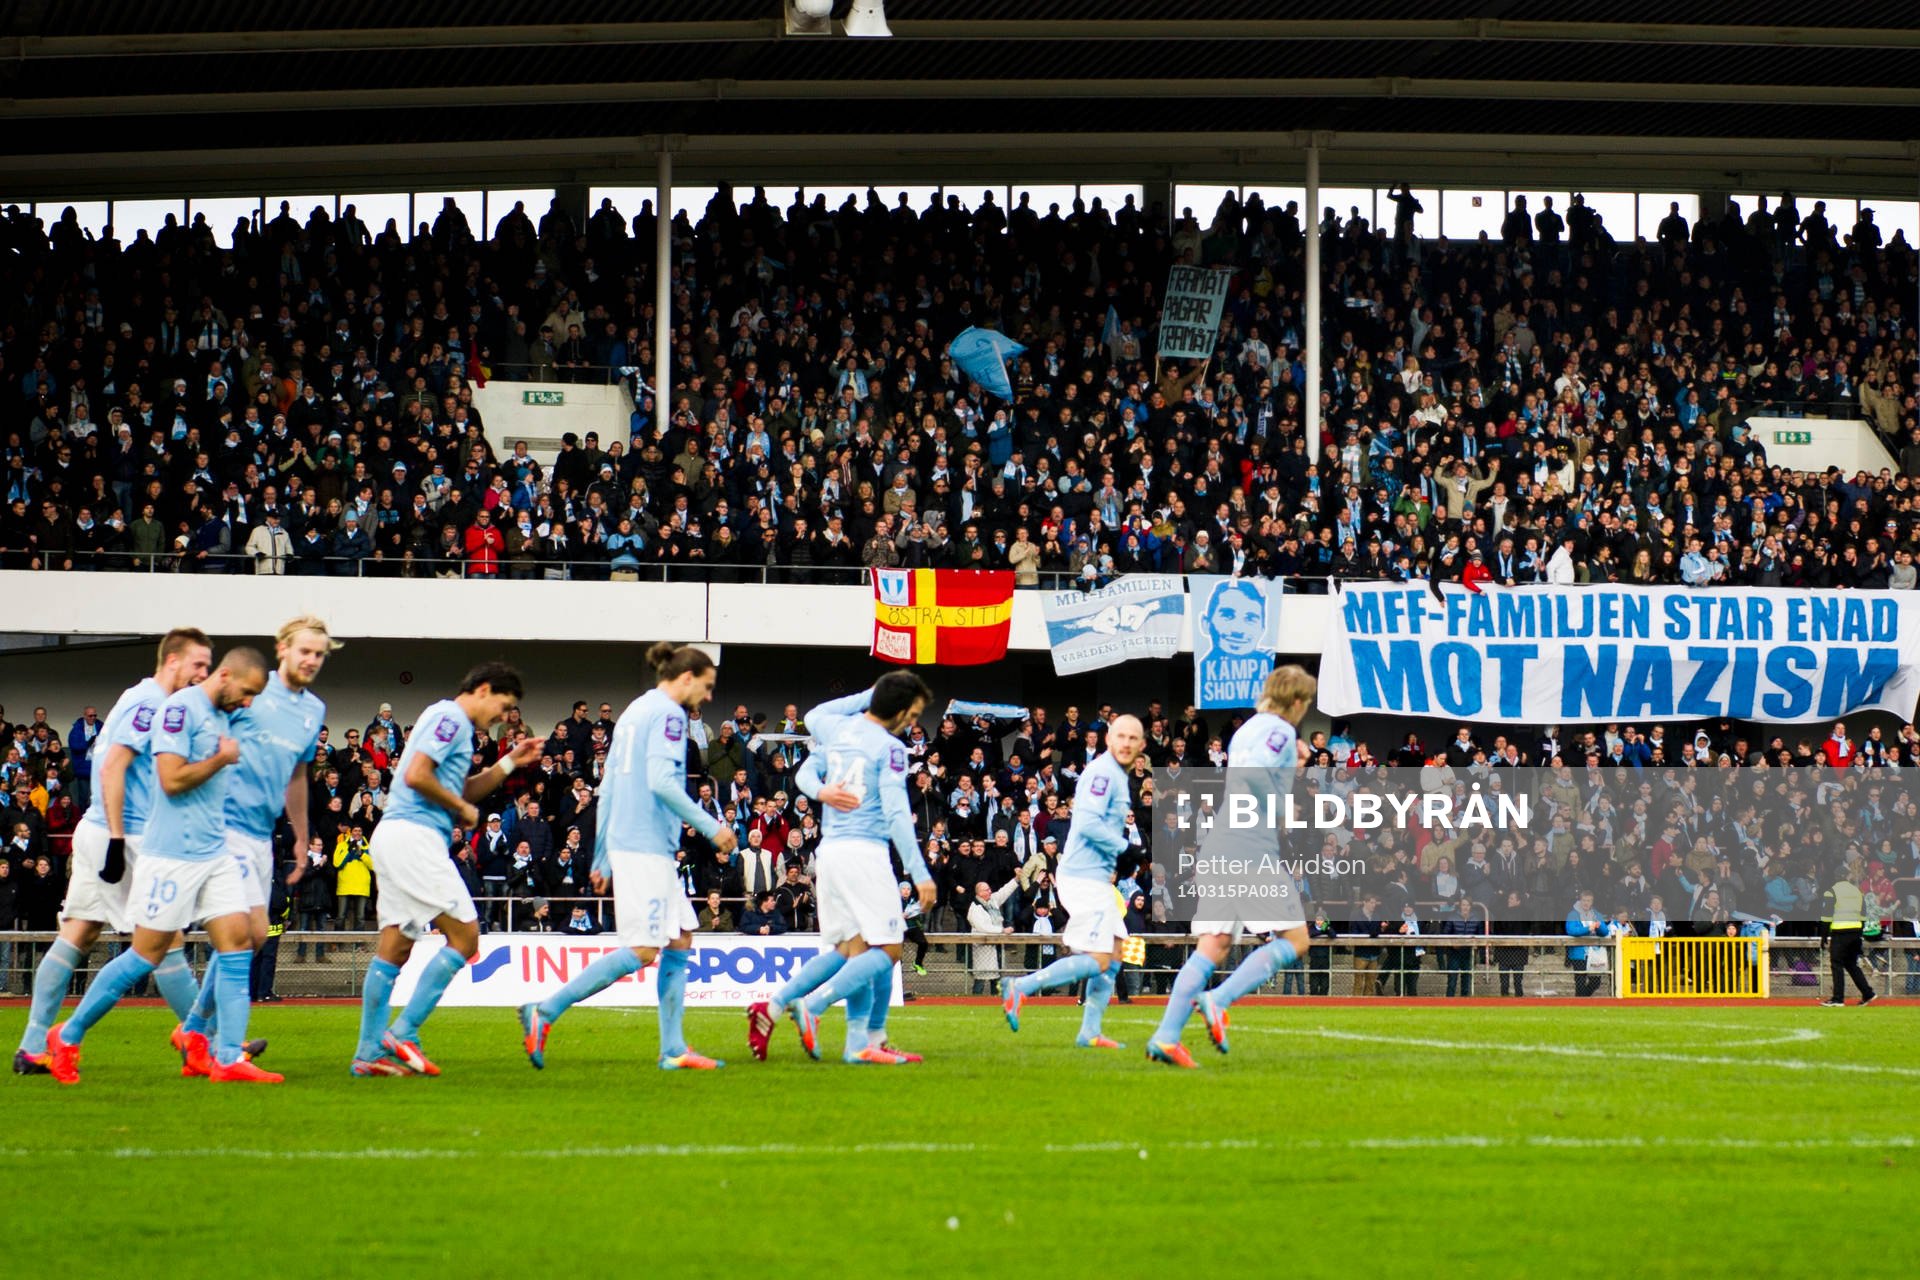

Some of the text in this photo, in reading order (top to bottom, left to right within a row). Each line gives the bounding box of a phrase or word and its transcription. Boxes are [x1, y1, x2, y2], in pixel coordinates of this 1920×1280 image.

[888, 605, 1000, 626] ÖSTRA SITT
[1343, 589, 1650, 639] MFF-FAMILJEN
[1787, 597, 1899, 642] ENAD
[1206, 656, 1270, 682] KÄMPA
[1350, 638, 1899, 719] MOT NAZISM
[1204, 680, 1265, 702] SHOWA
[149, 876, 177, 903] 10
